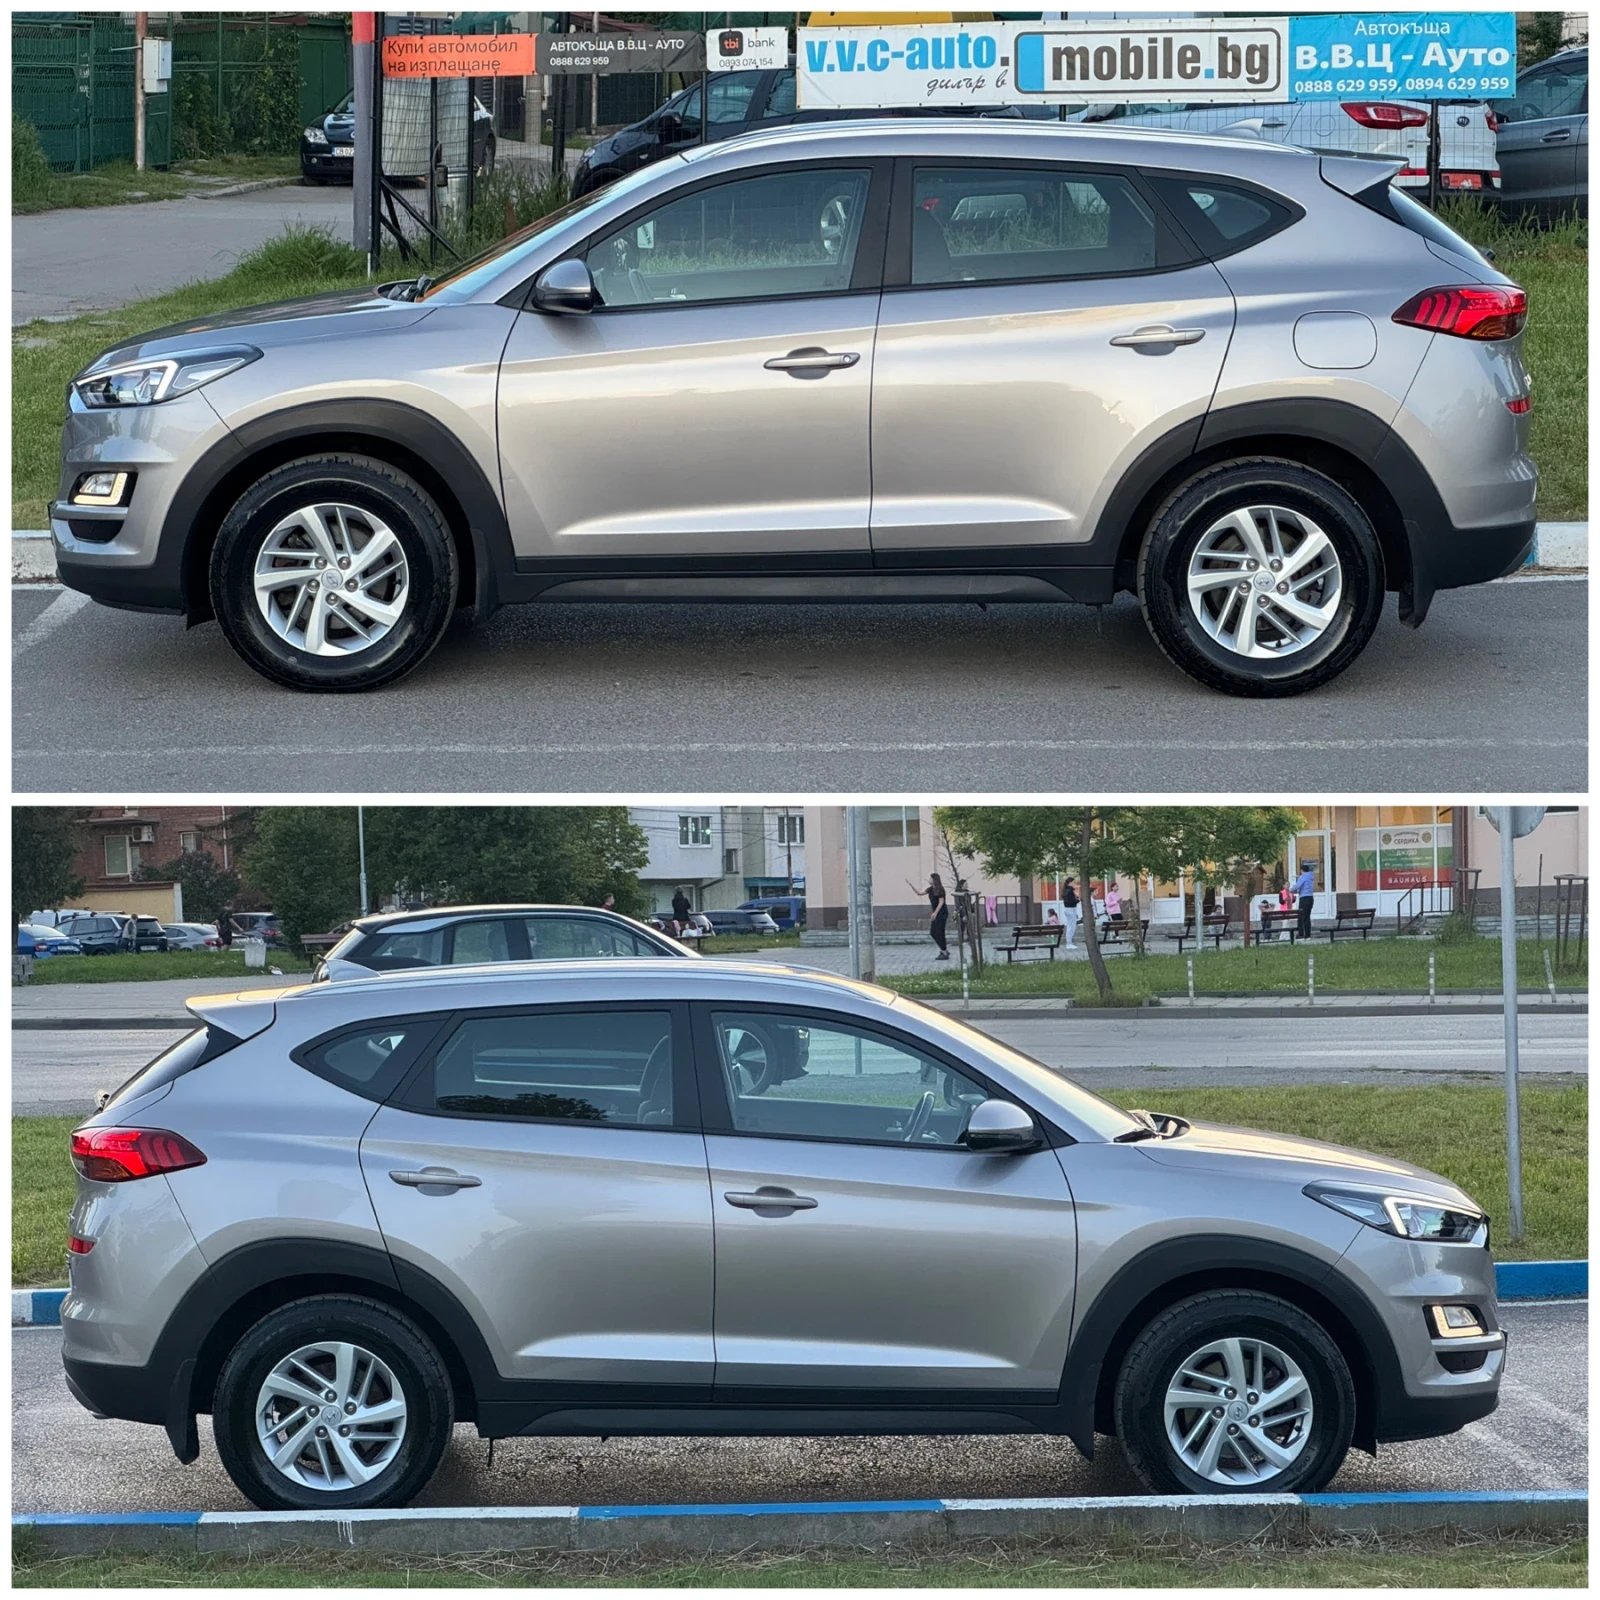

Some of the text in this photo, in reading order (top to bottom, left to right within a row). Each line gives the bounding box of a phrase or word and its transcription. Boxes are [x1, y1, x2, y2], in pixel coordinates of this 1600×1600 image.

[1354, 19, 1450, 36] Автокъща
[387, 40, 518, 56] Купи автомобил
[550, 40, 615, 52] АВТОКЪЩА
[616, 39, 647, 51] В.В.Ц
[655, 39, 685, 50] АУТО
[724, 37, 775, 49] tbi bank
[550, 56, 610, 66] 0888 629 959
[719, 58, 773, 68] 0893 074 154
[1051, 36, 1270, 84] mobile.bg
[1295, 43, 1393, 73] В.В.Ц
[1421, 42, 1510, 72] Ауто
[388, 59, 501, 72] на изплащане
[926, 73, 987, 97] дилър
[1295, 77, 1510, 93] 0888 629 959, 0894 629 959
[1388, 876, 1427, 884] BAUHAUS
